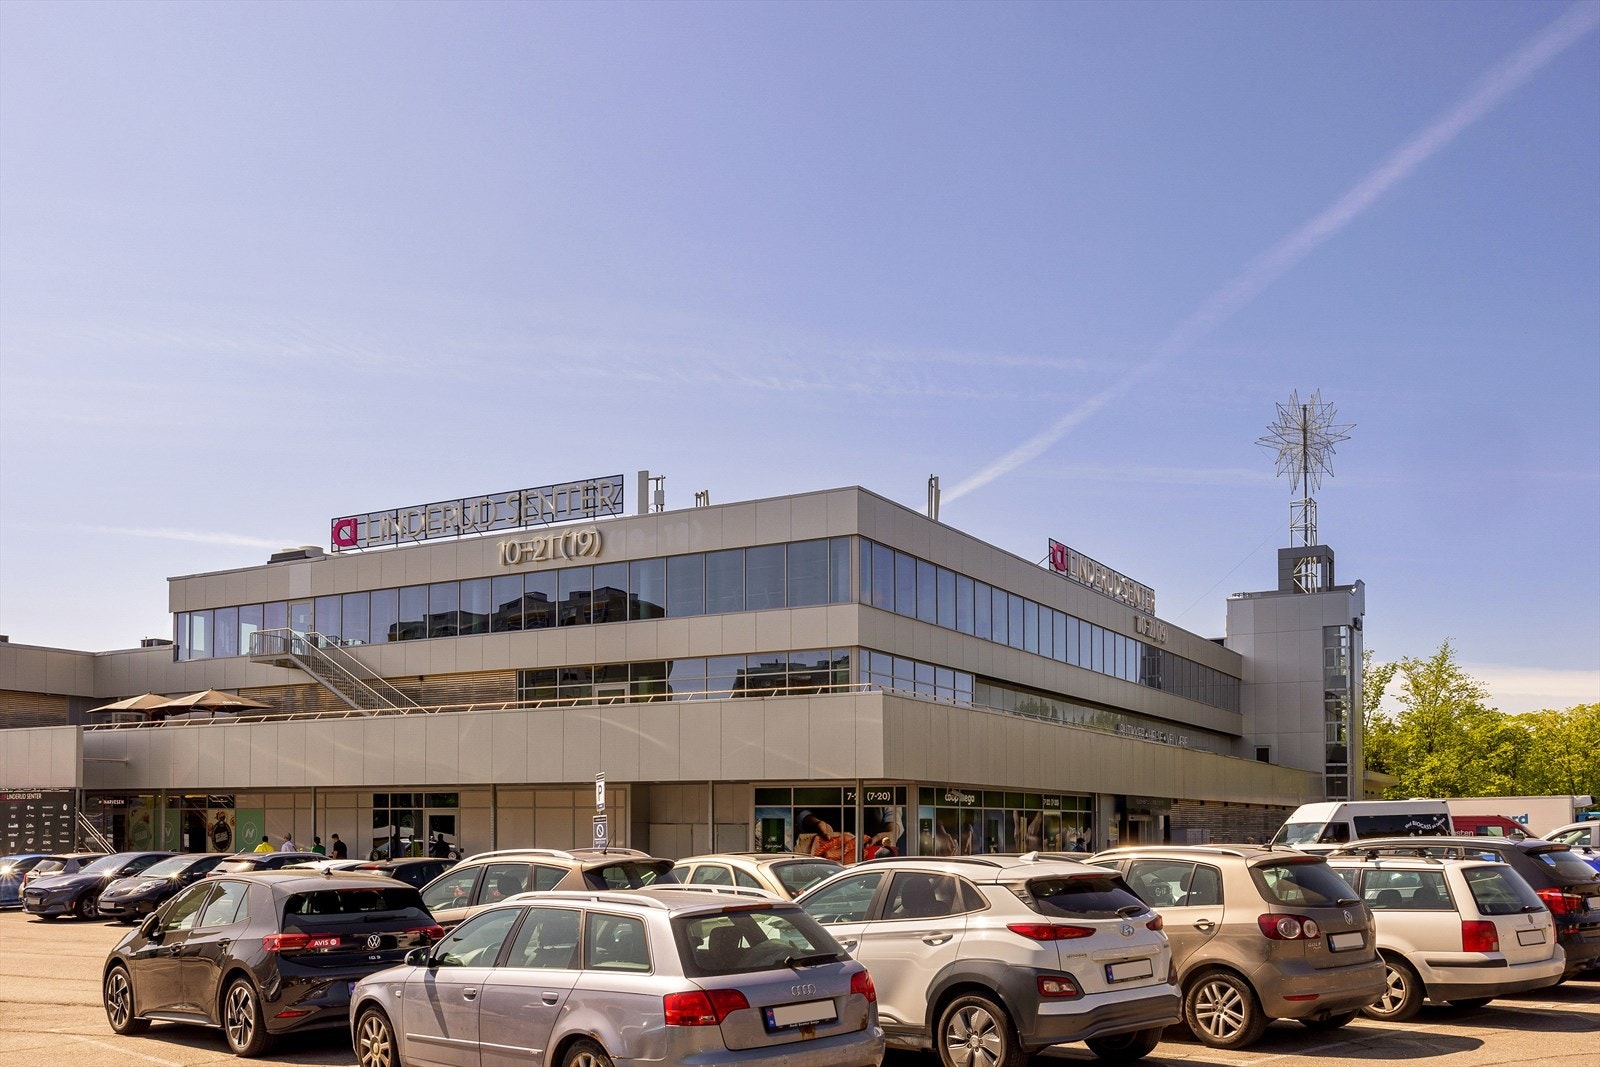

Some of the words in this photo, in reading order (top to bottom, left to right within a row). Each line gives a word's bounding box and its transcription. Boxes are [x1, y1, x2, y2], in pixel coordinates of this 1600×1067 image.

[365, 497, 498, 544] LINDERUD
[504, 479, 616, 524] SENTER
[497, 535, 554, 566] 10-21
[560, 526, 602, 560] (19)
[1069, 550, 1120, 597] LINDERUD
[1121, 577, 1155, 613] SENTER
[867, 792, 891, 801] (7-20)
